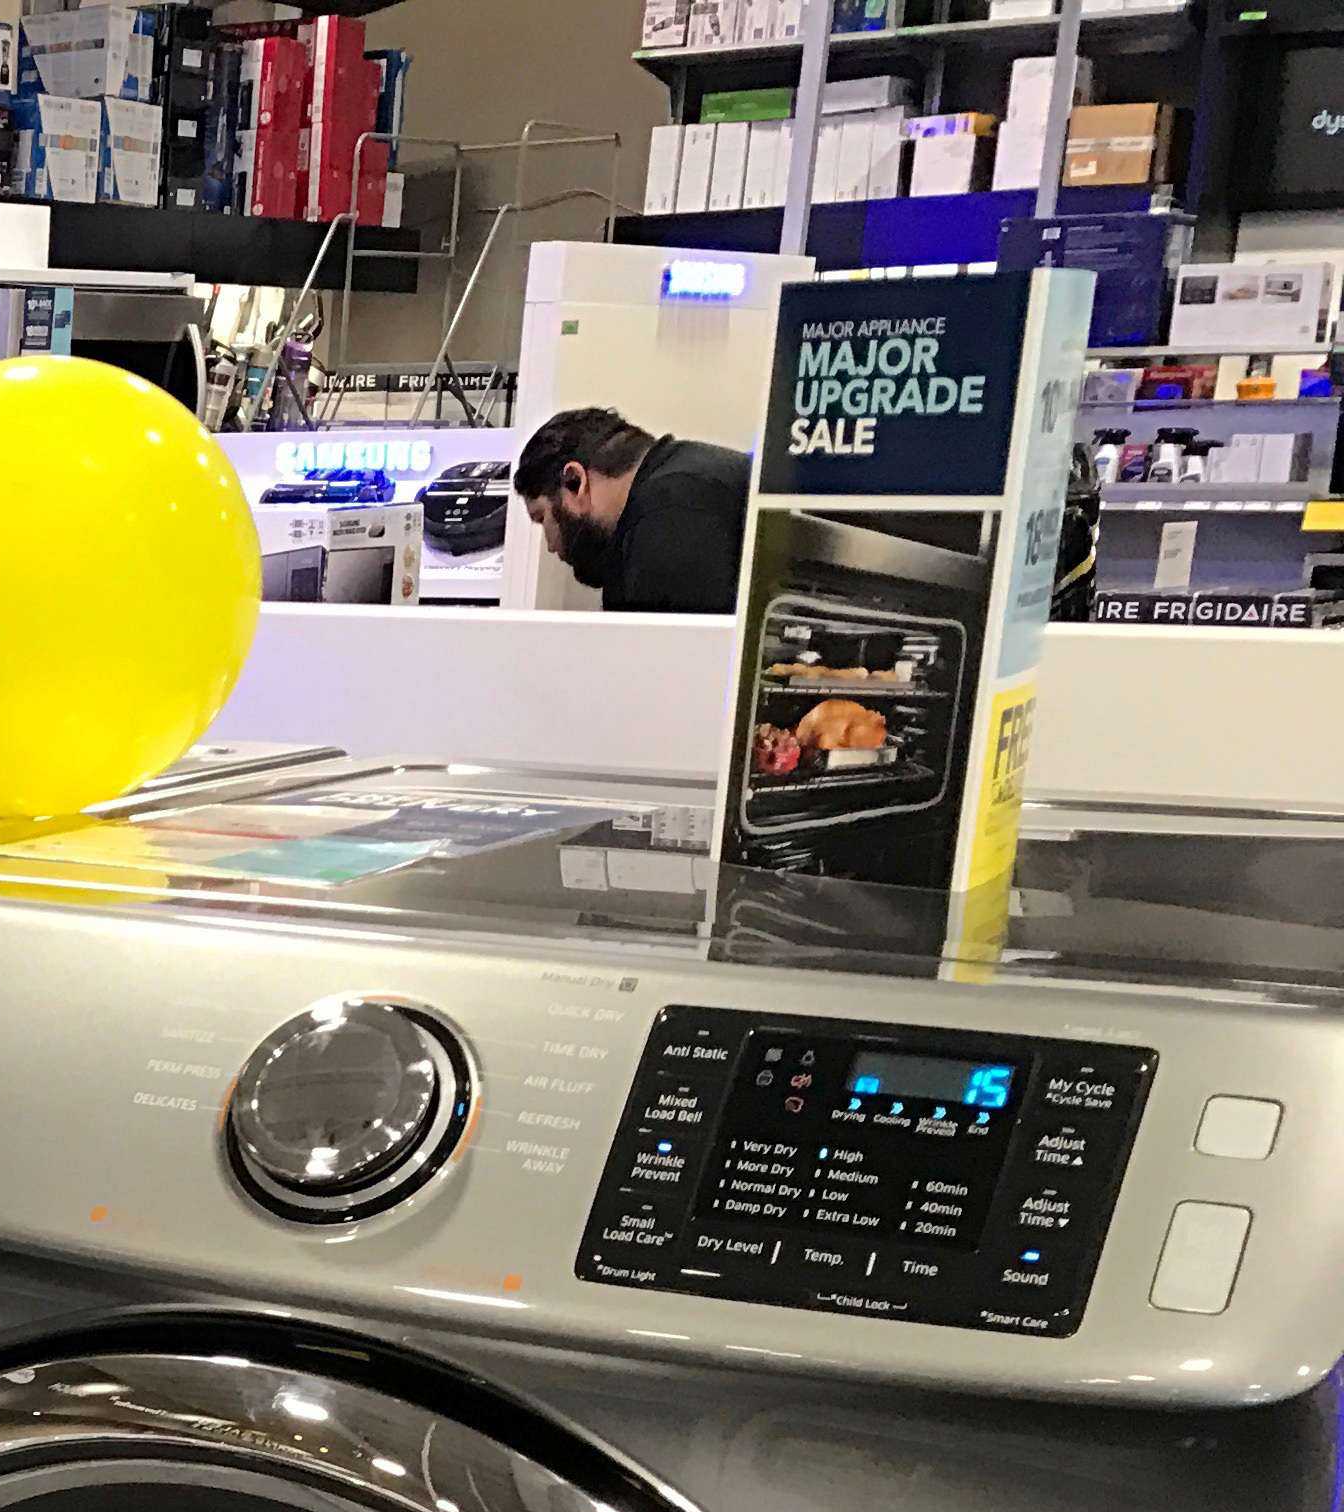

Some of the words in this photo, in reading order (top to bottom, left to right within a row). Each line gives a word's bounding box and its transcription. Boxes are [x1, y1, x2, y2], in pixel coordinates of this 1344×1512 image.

[1312, 109, 1344, 135] dys
[802, 320, 854, 339] MAJOR
[857, 317, 947, 336] APPLIANCE
[798, 337, 940, 378] MAJOR
[794, 375, 986, 415] UPGRADE
[788, 417, 877, 455] SALE
[1153, 601, 1307, 623] FRIGIDAIRE
[593, 1007, 624, 1023] DRY
[543, 1041, 577, 1056] TIME
[578, 1046, 609, 1060] DRY
[663, 1044, 691, 1058] Anti
[692, 1046, 729, 1061] Static
[146, 1059, 183, 1074] PERM
[183, 1064, 221, 1080] PRESS
[523, 1075, 550, 1089] AIR
[550, 1078, 595, 1093] FLUFF
[1049, 1077, 1074, 1094] My
[1075, 1080, 1116, 1098] Cycle
[133, 1091, 198, 1111] DELICATES
[658, 1094, 698, 1109] Mixed
[1084, 1096, 1113, 1109] Save
[518, 1111, 581, 1130] REFRESH
[644, 1107, 676, 1121] Load
[677, 1108, 703, 1123] Bell
[831, 1109, 866, 1122] Drying
[873, 1114, 911, 1127] Cooling
[968, 1125, 989, 1137] End
[506, 1140, 571, 1160] WRINKLE
[743, 1141, 770, 1155] Very
[771, 1144, 797, 1158] Dry
[1038, 1134, 1085, 1152] Adjust
[637, 1152, 685, 1168] Wrinkle
[833, 1149, 863, 1163] High
[1034, 1149, 1069, 1164] Time
[521, 1159, 566, 1174] AWAY
[631, 1167, 681, 1182] Prevent
[737, 1160, 769, 1174] More
[770, 1164, 794, 1178] Dry
[827, 1169, 878, 1185] Medium
[730, 1179, 775, 1195] Normal
[777, 1184, 802, 1199] Dry
[822, 1188, 849, 1202] Low
[925, 1180, 968, 1197] 60min
[725, 1200, 762, 1215] Damp
[763, 1203, 787, 1218] Dry
[919, 1200, 963, 1218] 40min
[1022, 1196, 1070, 1214] Adjust
[620, 1215, 655, 1230] Small
[815, 1209, 852, 1224] Extra
[853, 1212, 879, 1227] Low
[1019, 1211, 1054, 1228] Time
[603, 1228, 634, 1243] Load
[914, 1220, 957, 1238] 20min
[697, 1235, 724, 1251] Dry
[726, 1238, 763, 1255] Level
[804, 1247, 844, 1265] Temp.
[630, 1268, 657, 1281] Light
[903, 1260, 938, 1277] Time
[1002, 1269, 1049, 1287] Sound
[864, 1297, 890, 1310] Lock
[1021, 1316, 1049, 1329] Care
